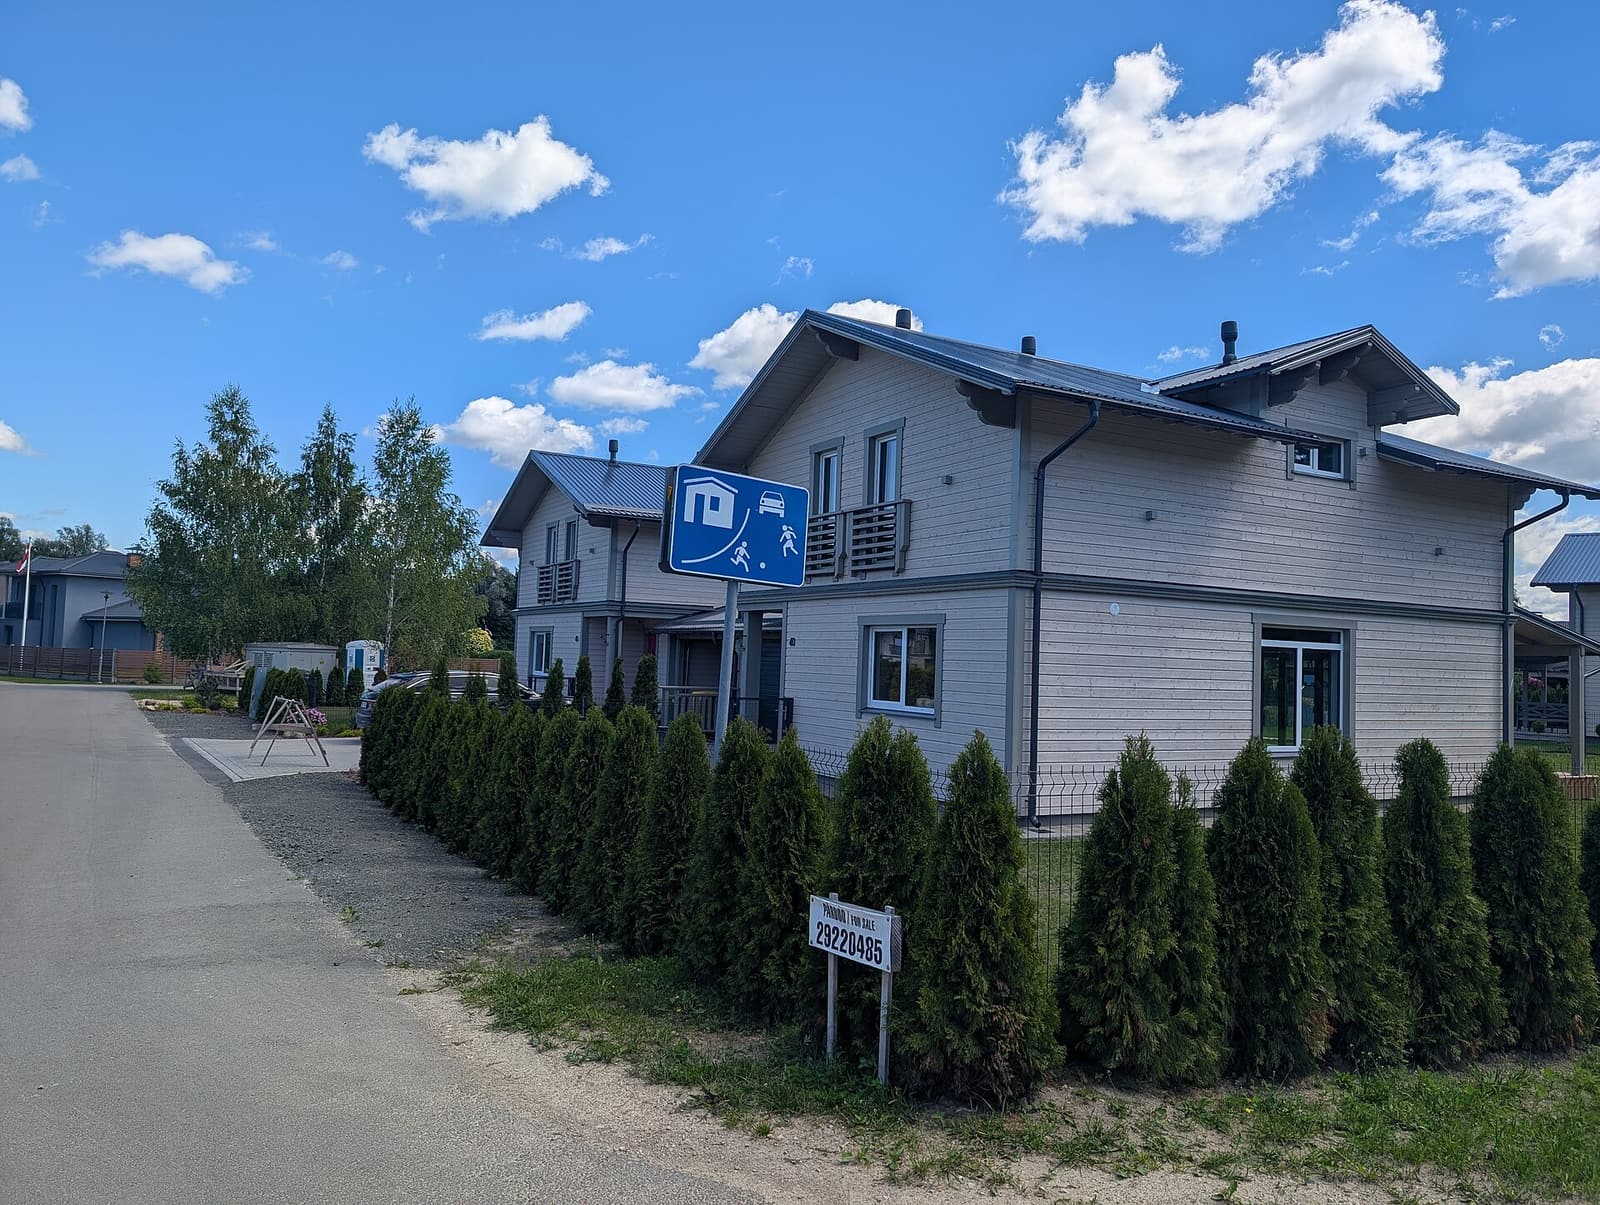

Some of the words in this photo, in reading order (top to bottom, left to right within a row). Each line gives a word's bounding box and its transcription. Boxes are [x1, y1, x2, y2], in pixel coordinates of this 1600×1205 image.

[851, 914, 861, 928] FOR
[862, 918, 875, 931] SALE
[816, 921, 883, 965] 29220485
